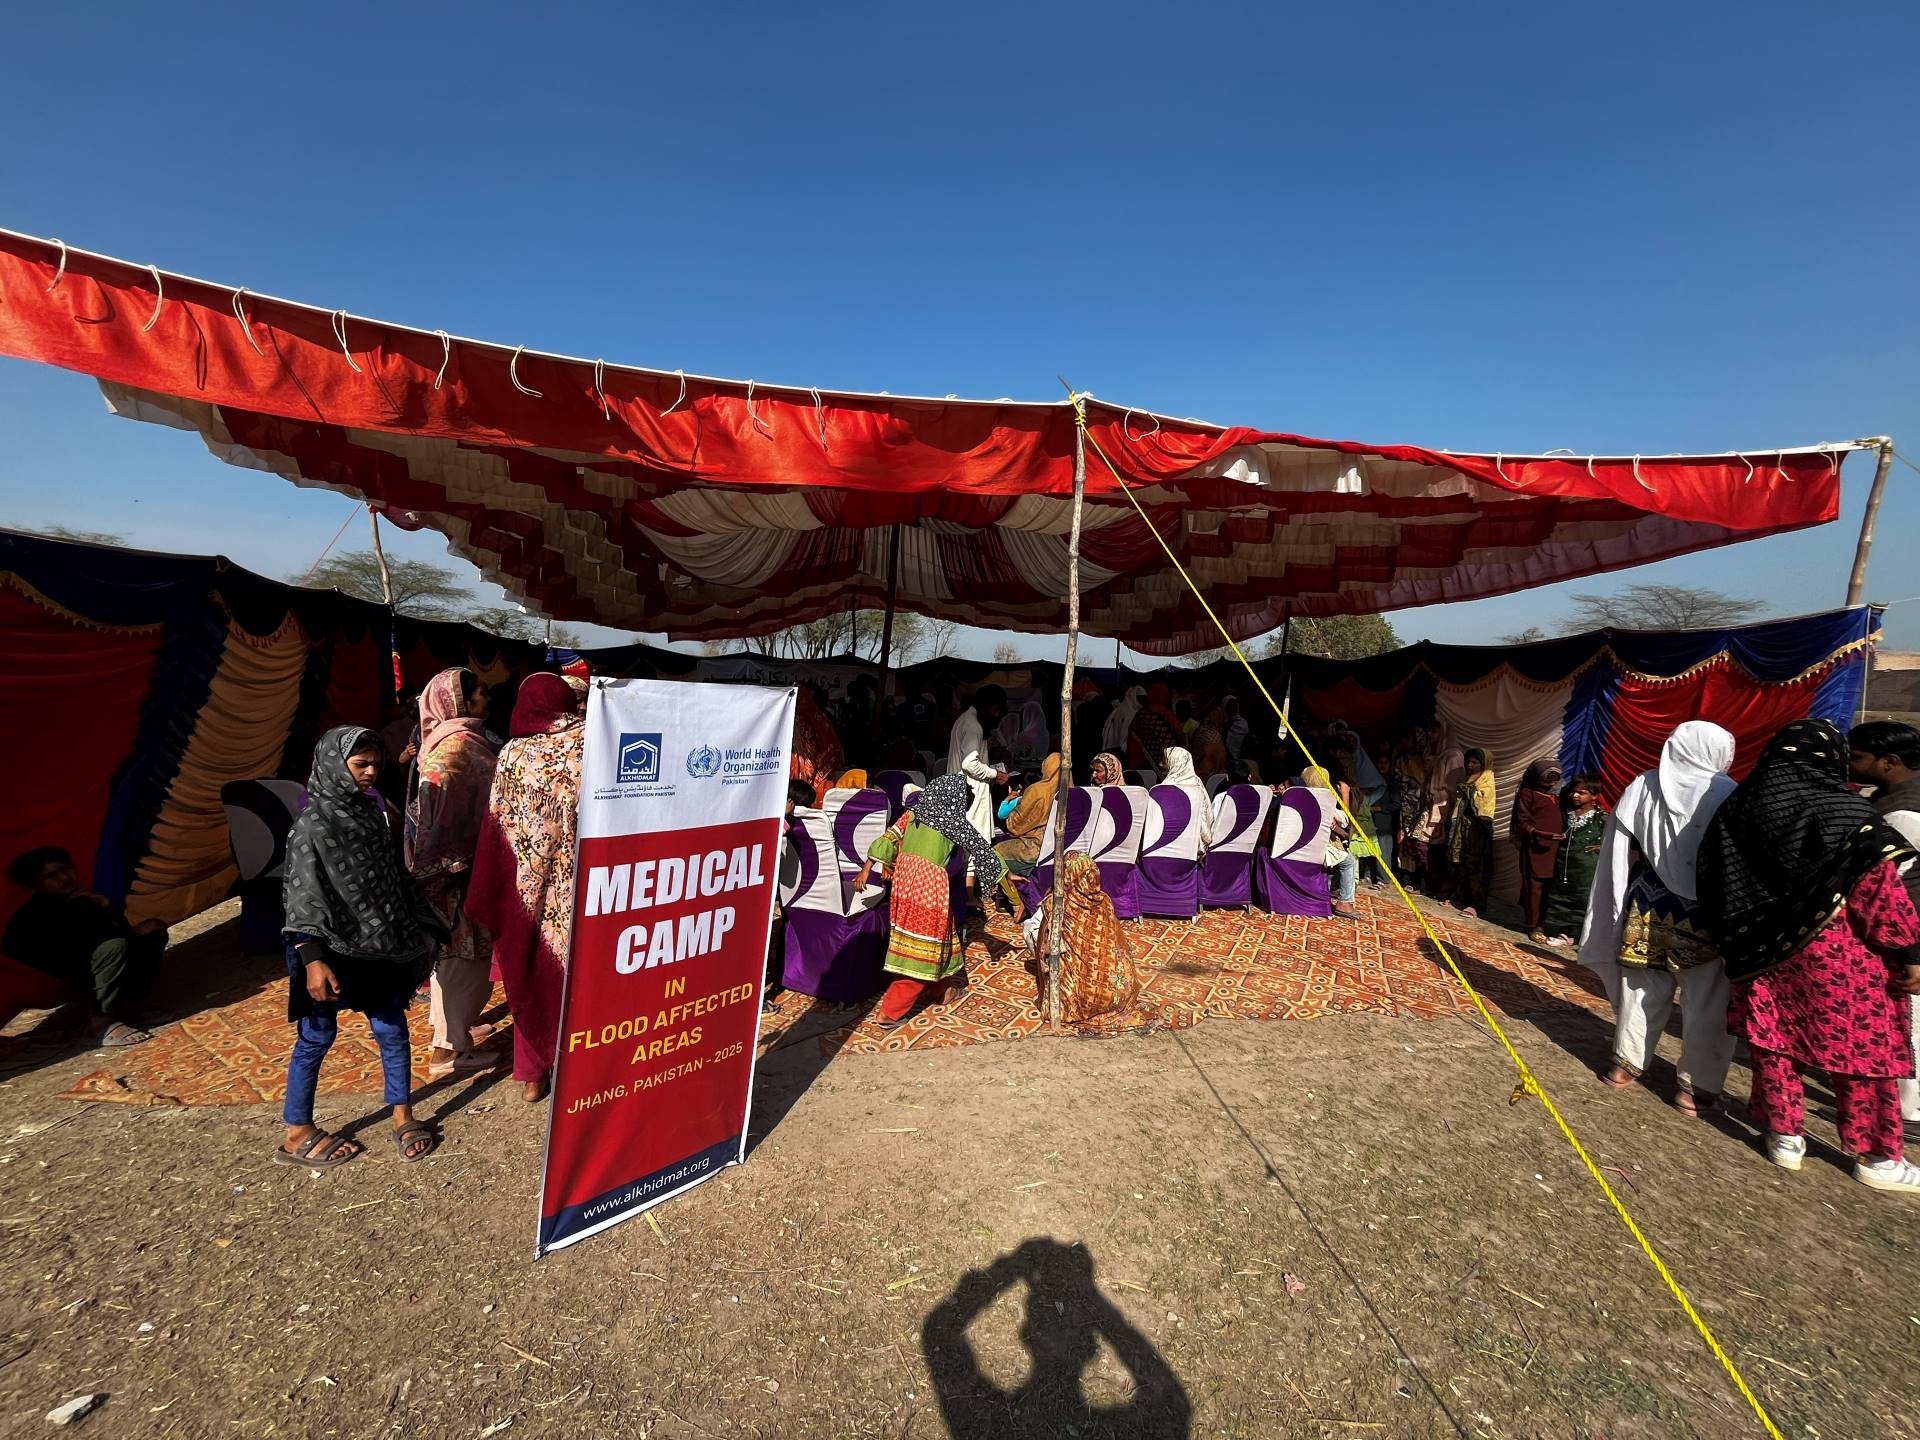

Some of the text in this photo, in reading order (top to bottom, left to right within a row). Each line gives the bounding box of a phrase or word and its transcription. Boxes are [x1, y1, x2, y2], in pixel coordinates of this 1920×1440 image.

[723, 759, 779, 774] Organization
[725, 746, 781, 760] World Health
[584, 843, 765, 918] MEDICAL
[615, 906, 735, 975] CAMP
[568, 982, 753, 1052] FLOOD AFFECTED
[664, 976, 686, 998] IN
[567, 1084, 629, 1114] JHANG,
[633, 1059, 703, 1093] PAKISTAN
[713, 1041, 743, 1064] 2025
[630, 1026, 703, 1064] AREAS
[583, 1155, 710, 1220] www.alkhidmat.org
